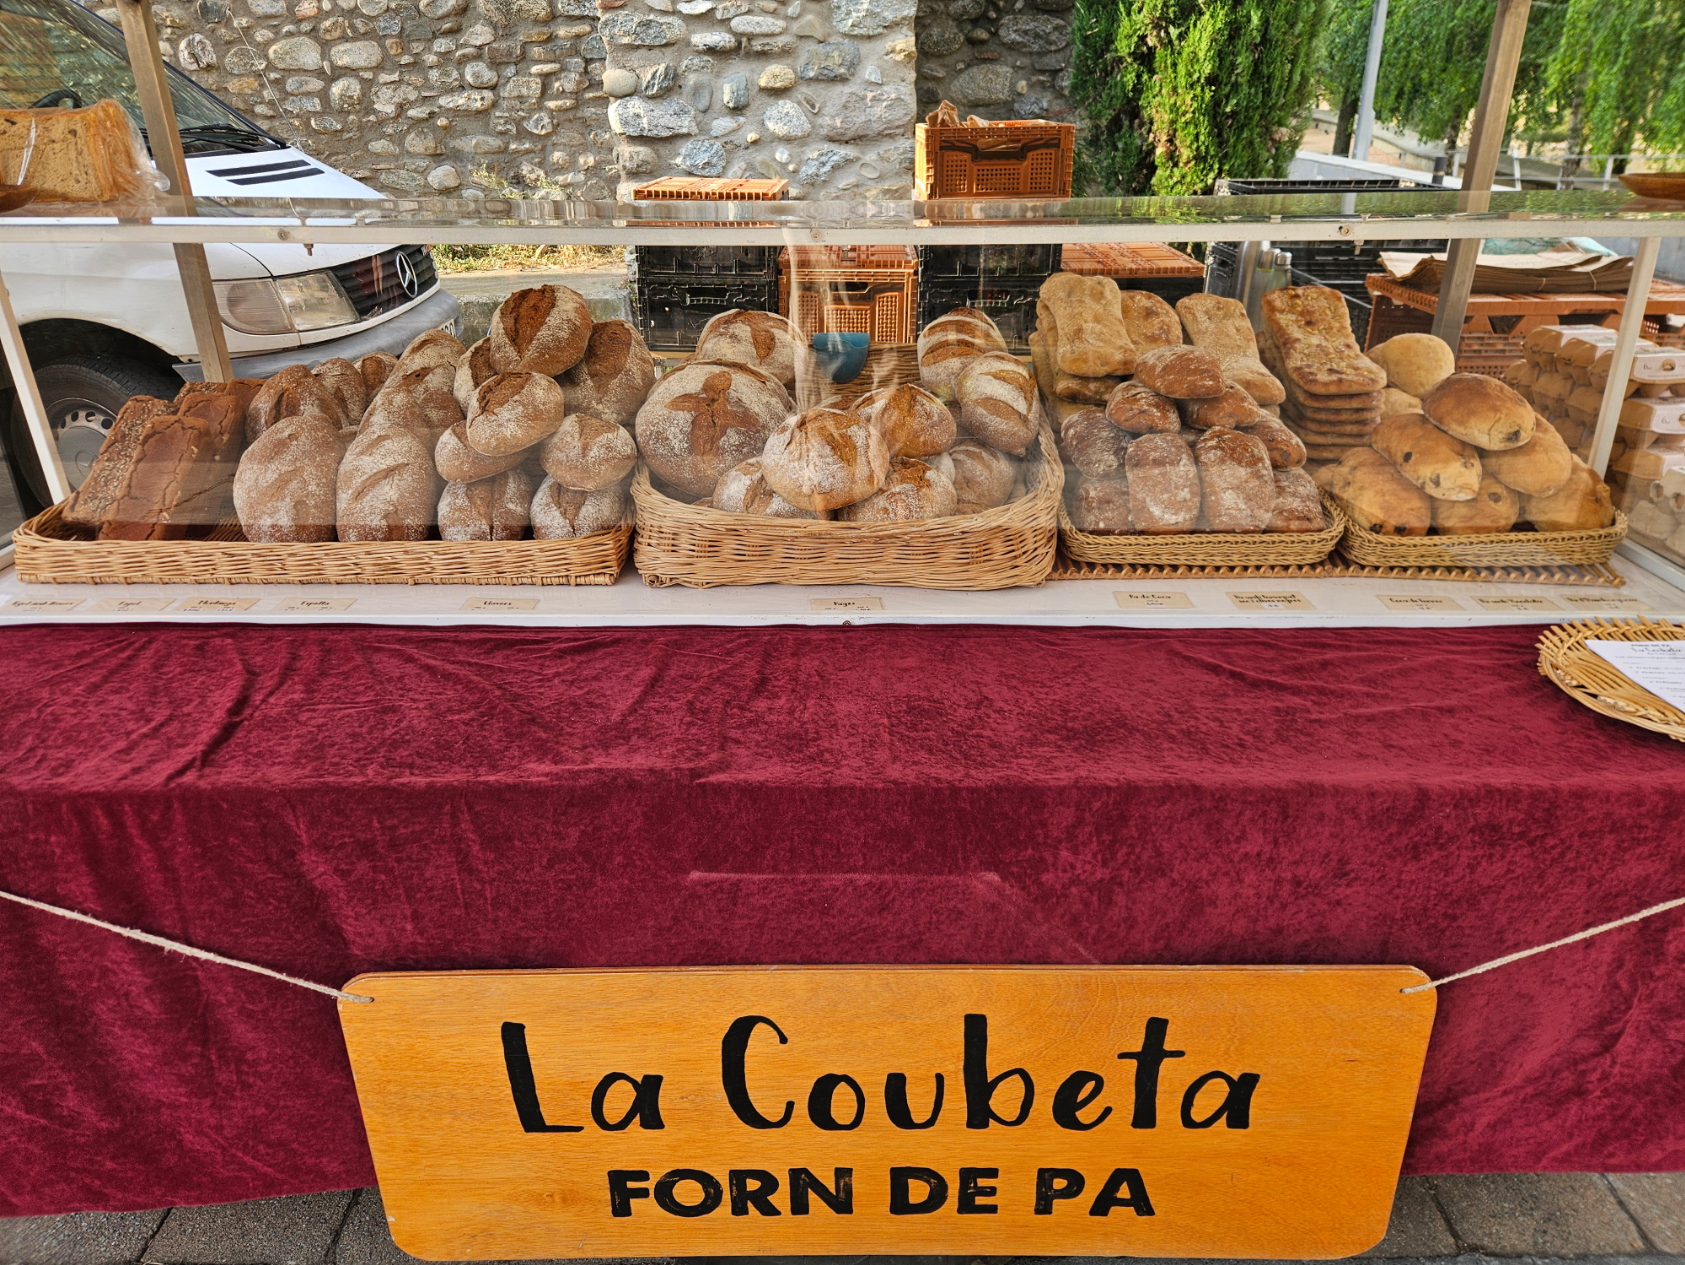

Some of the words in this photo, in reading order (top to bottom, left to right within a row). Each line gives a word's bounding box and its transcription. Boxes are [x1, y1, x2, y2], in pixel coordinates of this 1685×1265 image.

[501, 1022, 665, 1133] La
[722, 1014, 1260, 1131] Coubeta
[608, 1167, 853, 1217] FORN
[890, 1167, 999, 1215] DE
[1034, 1168, 1155, 1216] PA
